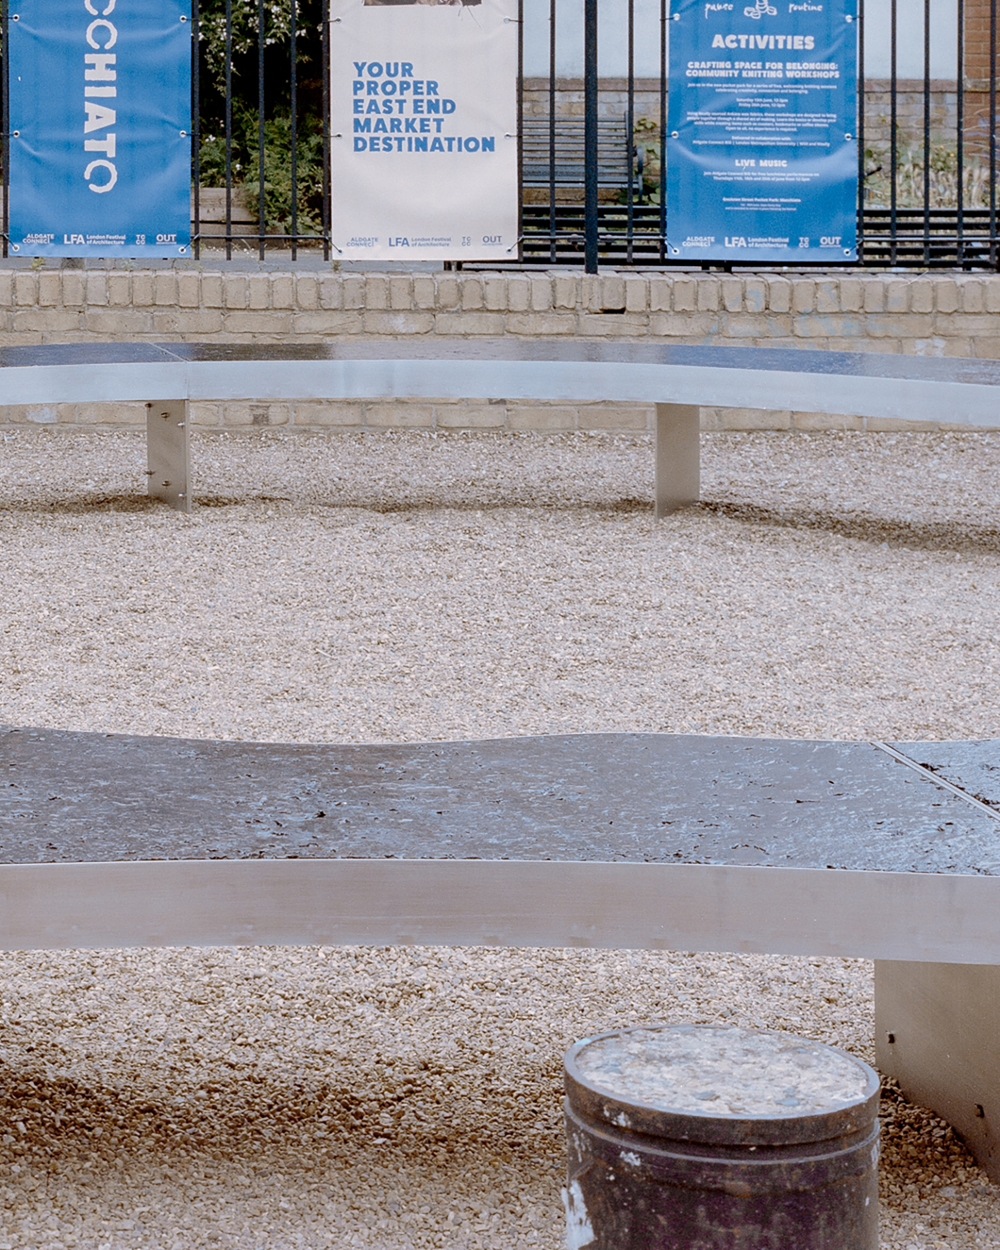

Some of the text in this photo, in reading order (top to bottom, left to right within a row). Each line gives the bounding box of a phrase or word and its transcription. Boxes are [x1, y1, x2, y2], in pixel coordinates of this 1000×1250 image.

[704, 3, 734, 19] pause
[788, 0, 823, 13] routine
[711, 34, 815, 50] ACTIVITIES
[353, 61, 414, 78] YOUR
[687, 61, 732, 69] CRAFTING
[734, 61, 762, 70] SPACE
[765, 62, 783, 70] FOR
[685, 69, 840, 79] COMMUNITY KNITTING WORKSHOPS
[352, 80, 439, 96] PROPER
[353, 98, 456, 114] EAST END
[353, 117, 445, 133] MARKET
[353, 136, 496, 153] DESTINATION
[735, 159, 788, 167] LIVE MUSIC
[64, 234, 85, 245] LFA
[156, 234, 177, 242] OUT
[388, 237, 410, 247] LFA
[482, 235, 502, 243] OUT
[725, 236, 747, 247] LFA
[820, 236, 841, 245] OUT
